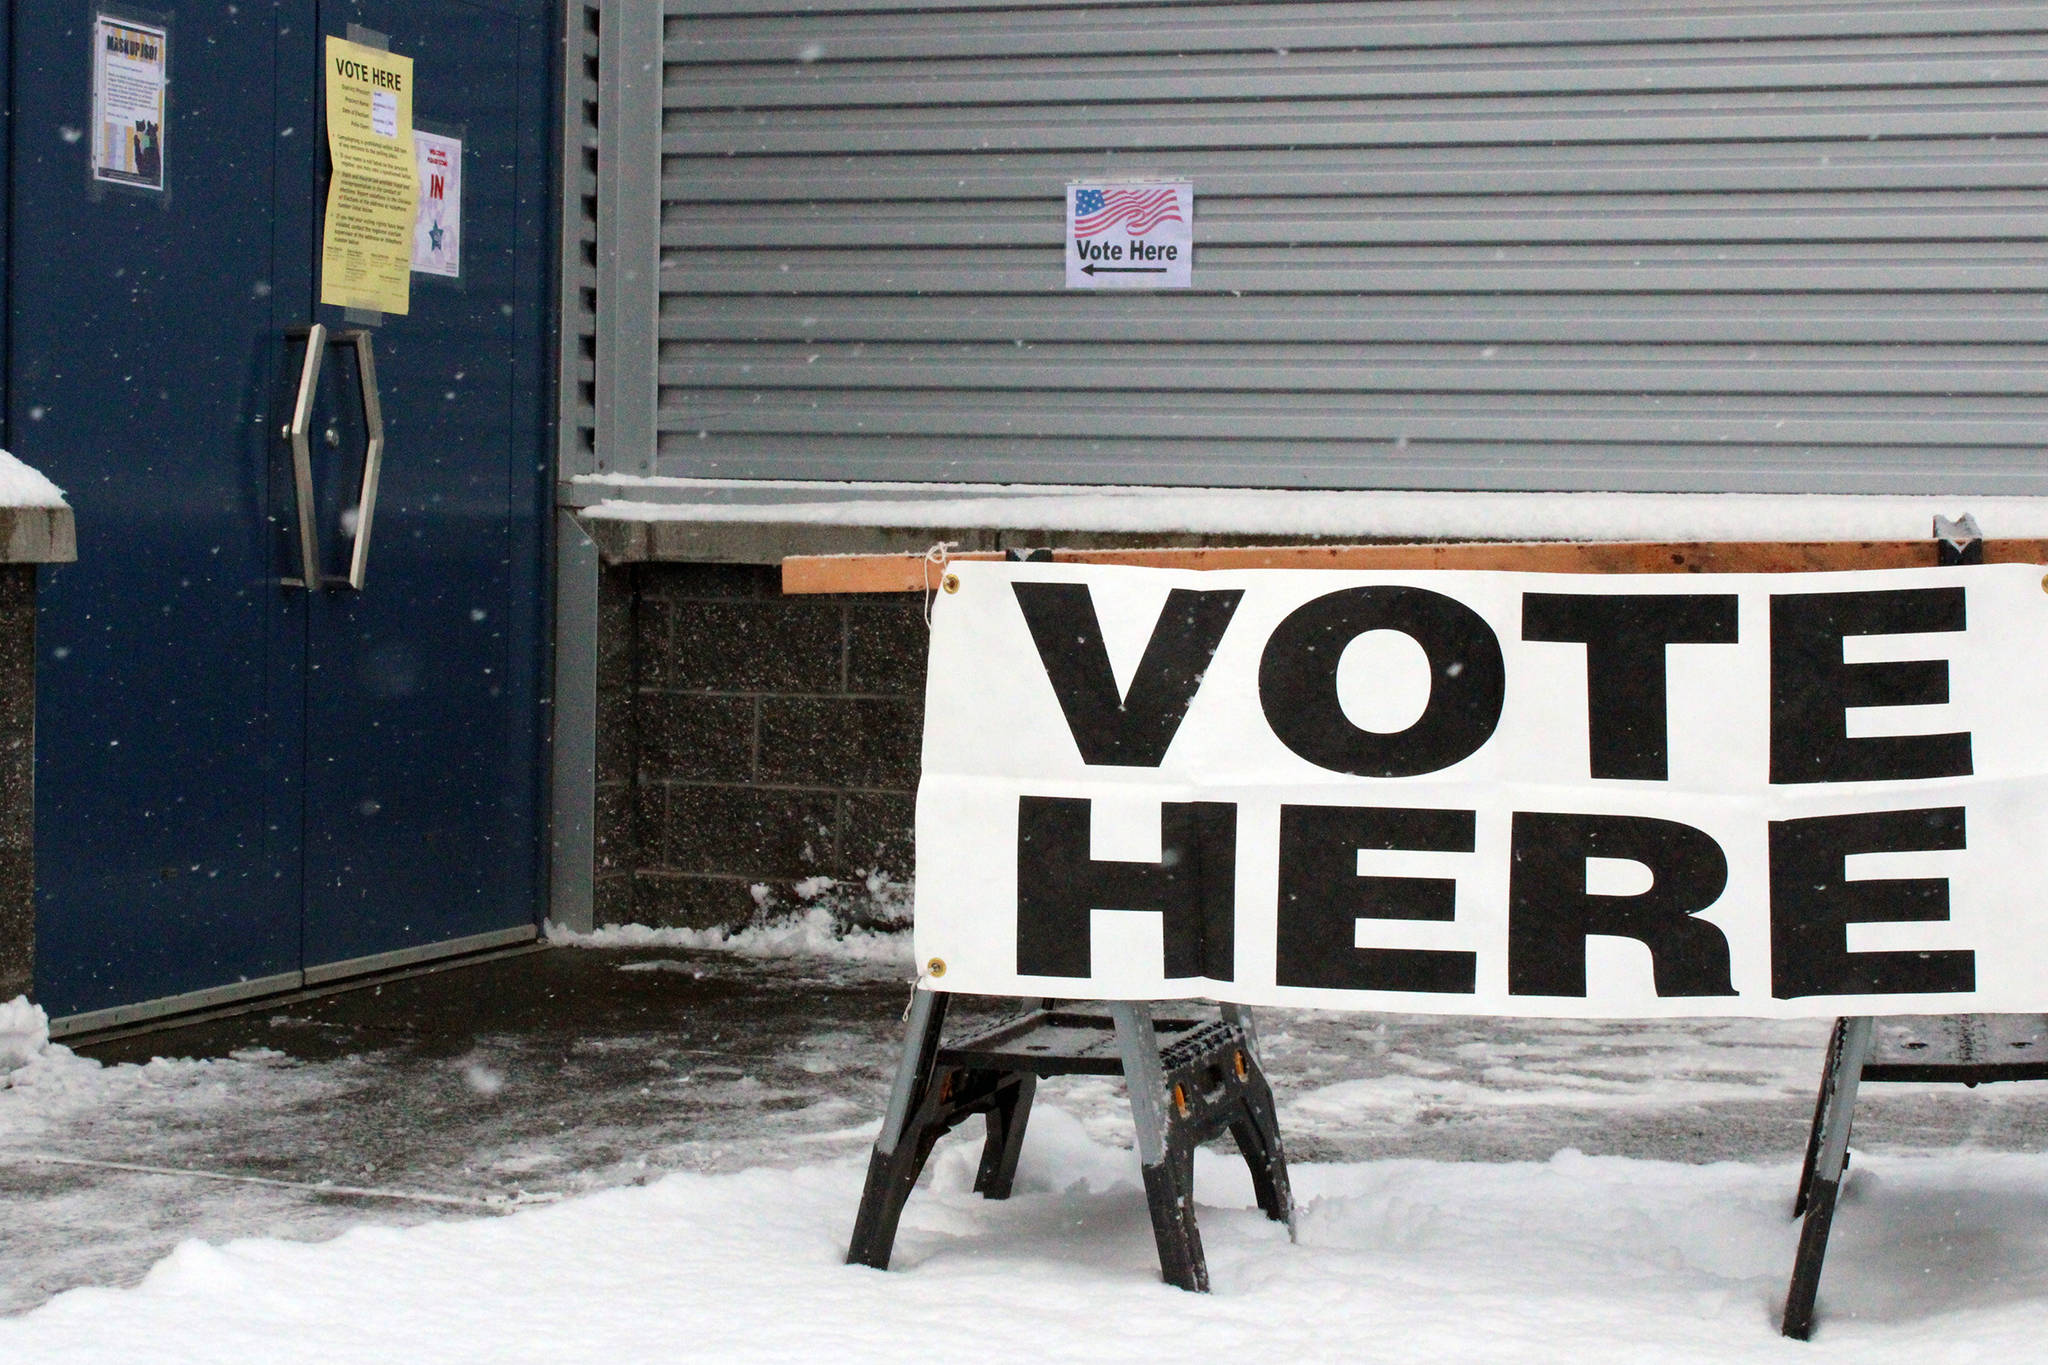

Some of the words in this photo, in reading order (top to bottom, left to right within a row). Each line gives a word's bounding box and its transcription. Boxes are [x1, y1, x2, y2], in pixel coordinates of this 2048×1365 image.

[336, 57, 368, 82] VOTE
[372, 67, 401, 91] HERE
[430, 173, 444, 200] IN
[1076, 240, 1122, 261] Vote
[1130, 240, 1177, 261] Here
[1011, 582, 1974, 784] VOTE
[1016, 795, 1976, 1000] HERE
